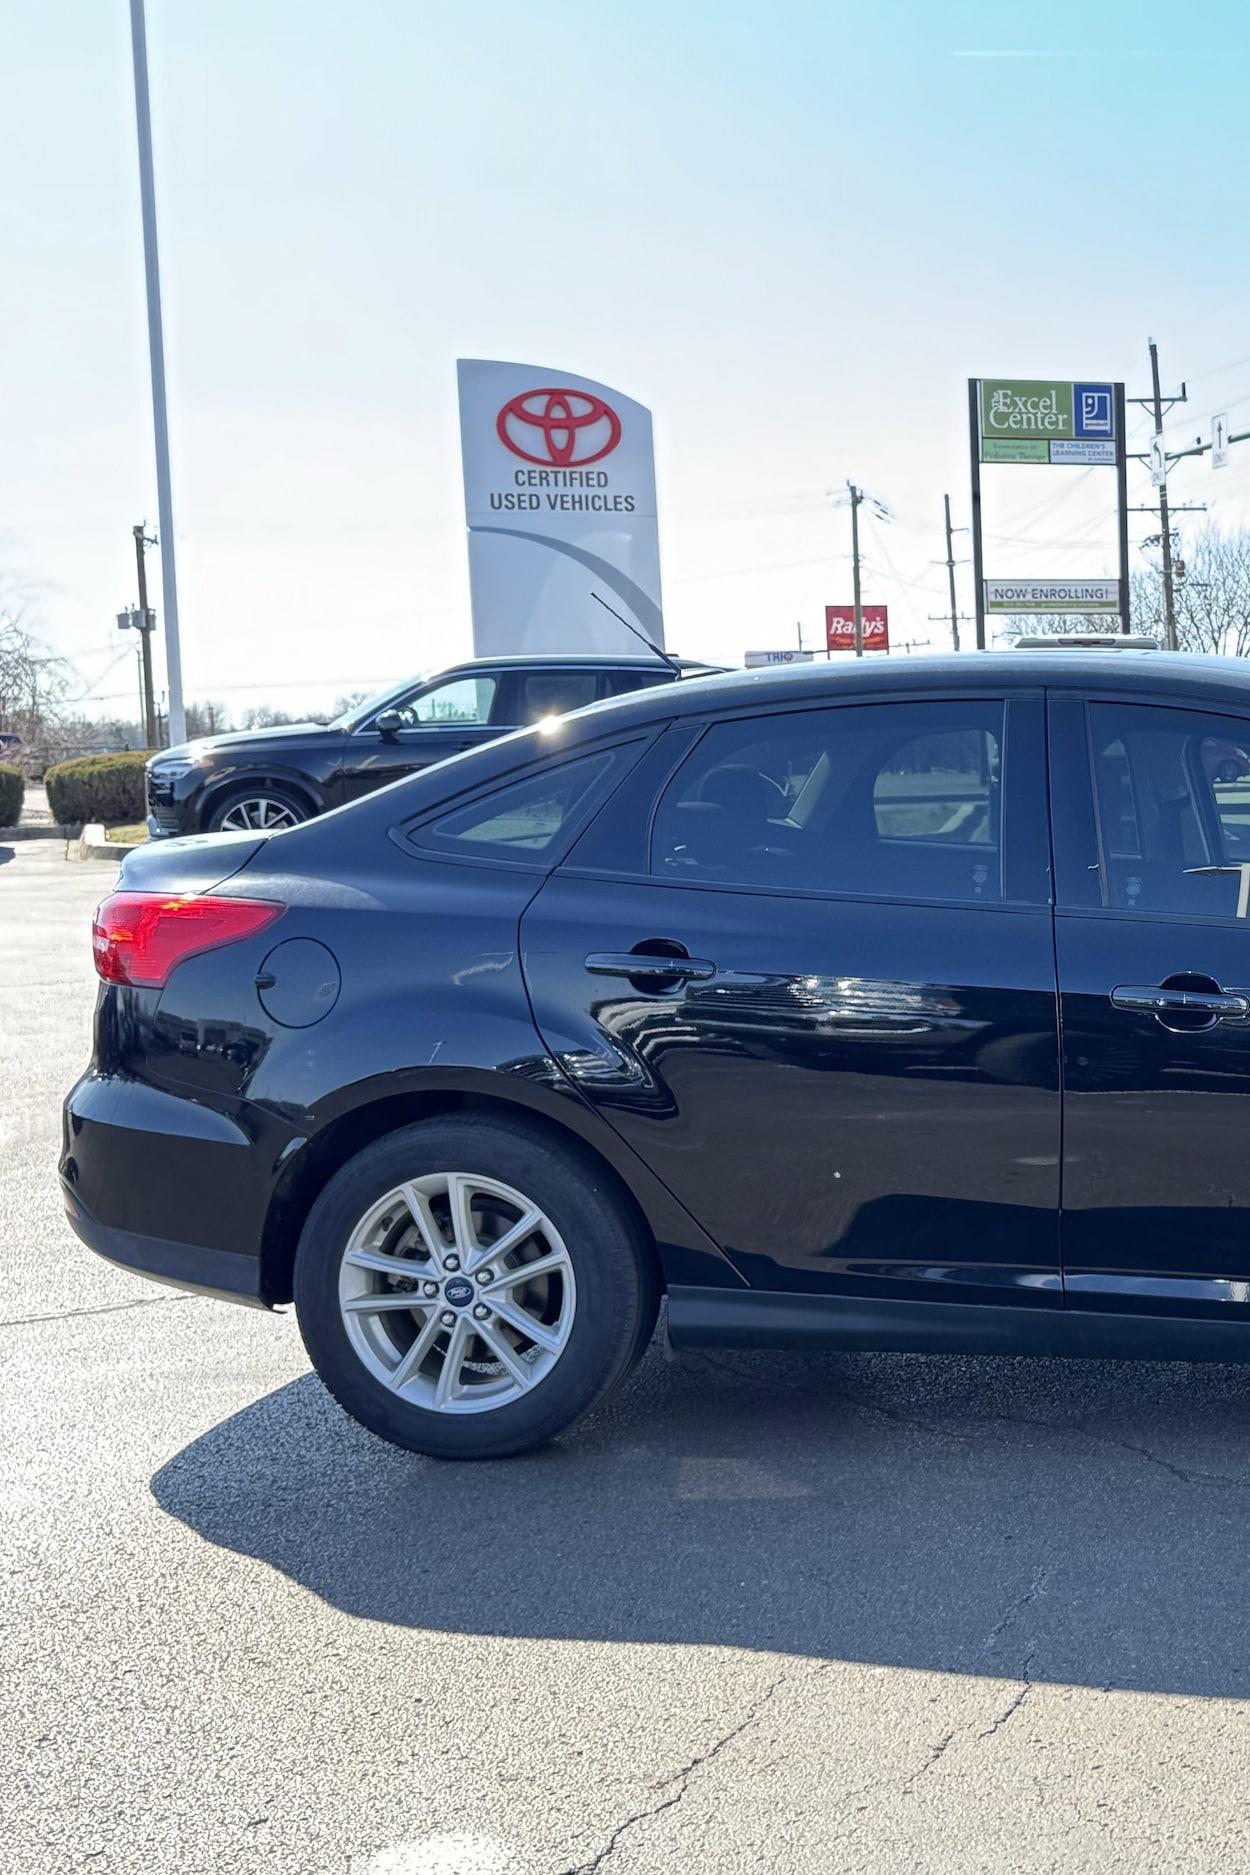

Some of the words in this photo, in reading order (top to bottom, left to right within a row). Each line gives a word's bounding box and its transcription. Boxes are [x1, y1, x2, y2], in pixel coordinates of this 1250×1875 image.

[997, 389, 1058, 413] Excel
[989, 405, 1068, 430] Center
[1066, 442, 1106, 450] CHILDREN'S
[514, 469, 609, 488] CERTIFIED
[490, 493, 541, 511] USED
[546, 493, 636, 513] VEHICLES
[994, 588, 1028, 599] NOW
[1031, 588, 1109, 600] ENROLLING!
